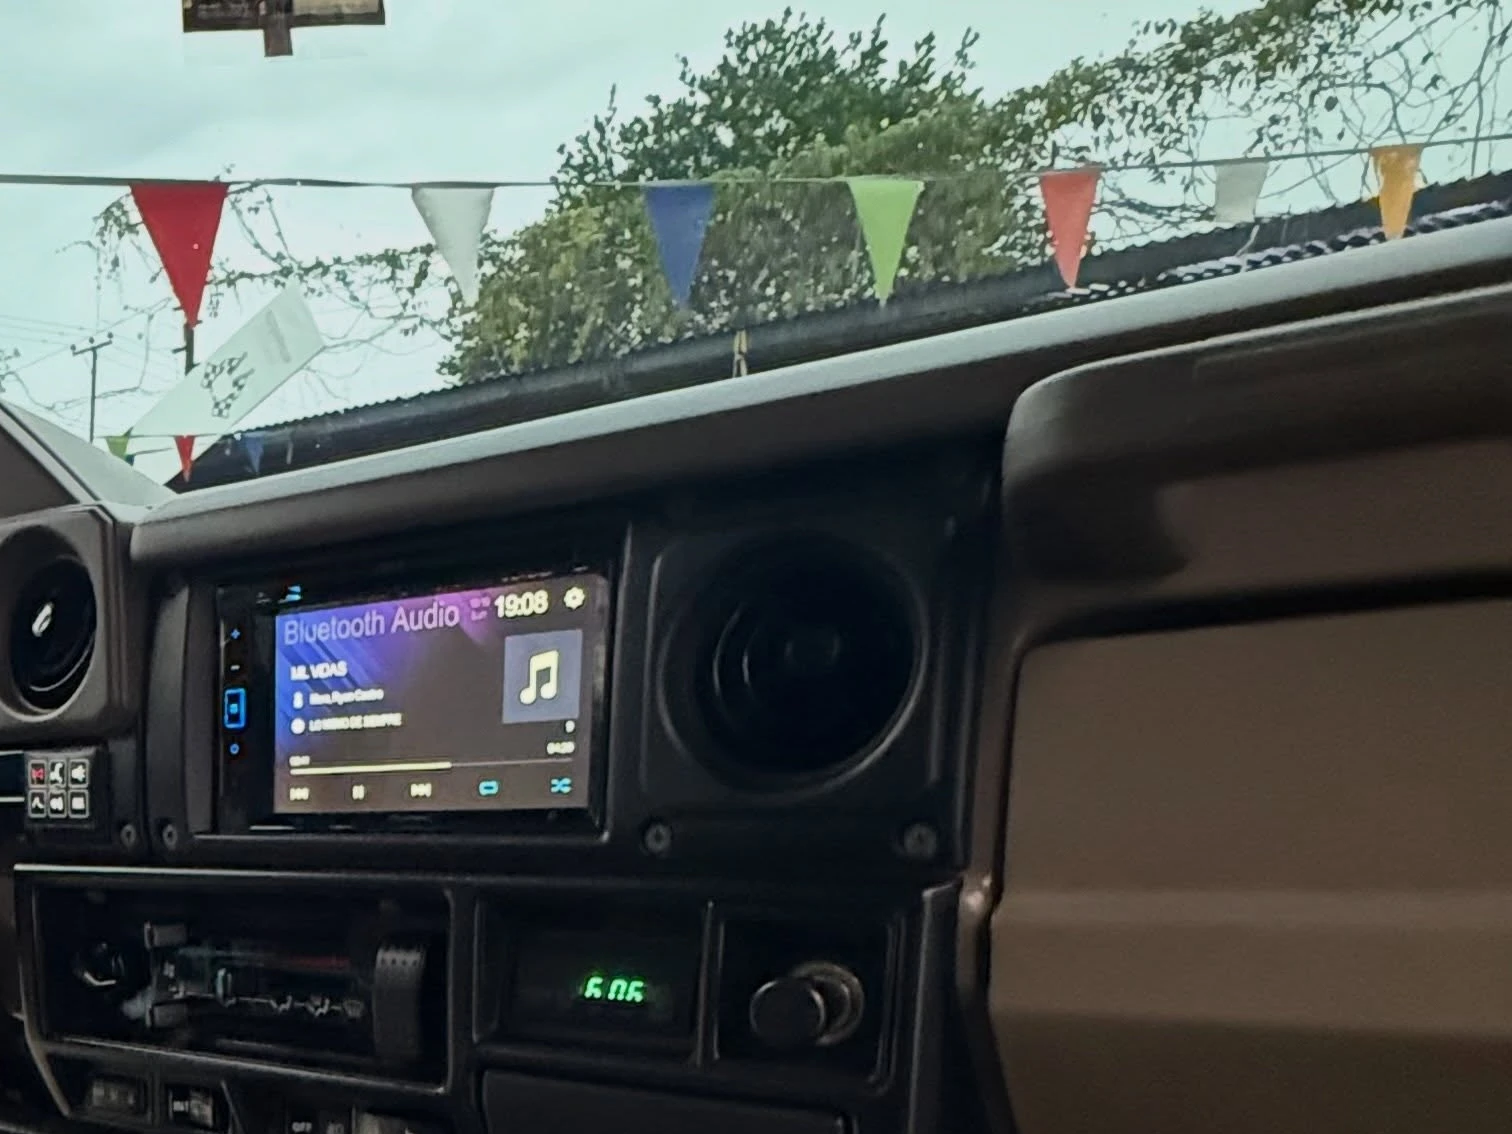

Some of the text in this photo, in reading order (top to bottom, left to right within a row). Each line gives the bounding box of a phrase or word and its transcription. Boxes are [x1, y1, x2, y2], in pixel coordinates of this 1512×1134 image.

[494, 589, 549, 618] 19:08
[284, 601, 460, 645] Bluetooth Audio
